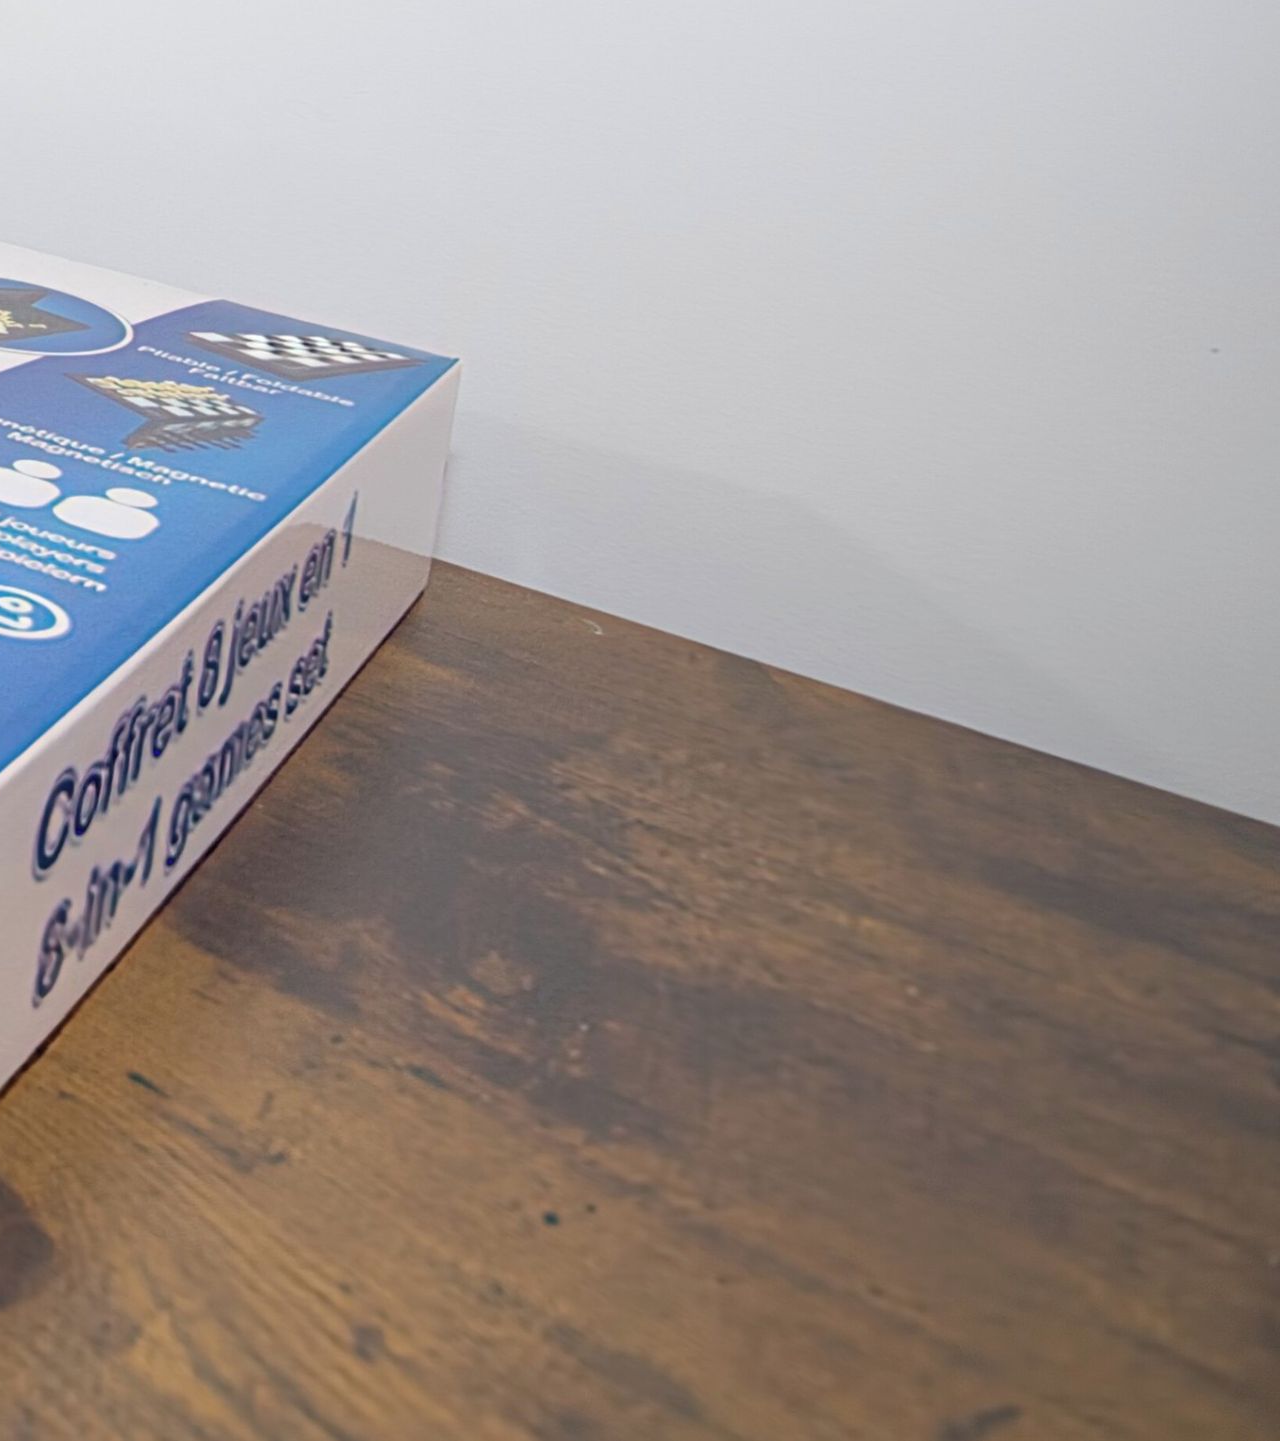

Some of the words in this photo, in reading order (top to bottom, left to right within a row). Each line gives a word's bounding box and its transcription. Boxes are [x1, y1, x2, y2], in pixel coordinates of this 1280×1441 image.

[137, 345, 220, 373] Pliable
[238, 374, 355, 407] Foldable
[188, 367, 284, 396] Faltbar
[6, 430, 171, 486] Magnetisch
[127, 455, 267, 502] Magnetic
[33, 650, 195, 880] Coffret
[197, 619, 225, 716] 8
[218, 597, 298, 707] jeux
[297, 527, 338, 612] en
[342, 490, 358, 567] 1
[33, 796, 162, 1008] 8-in-1
[164, 680, 283, 877] games
[283, 611, 335, 722] set
